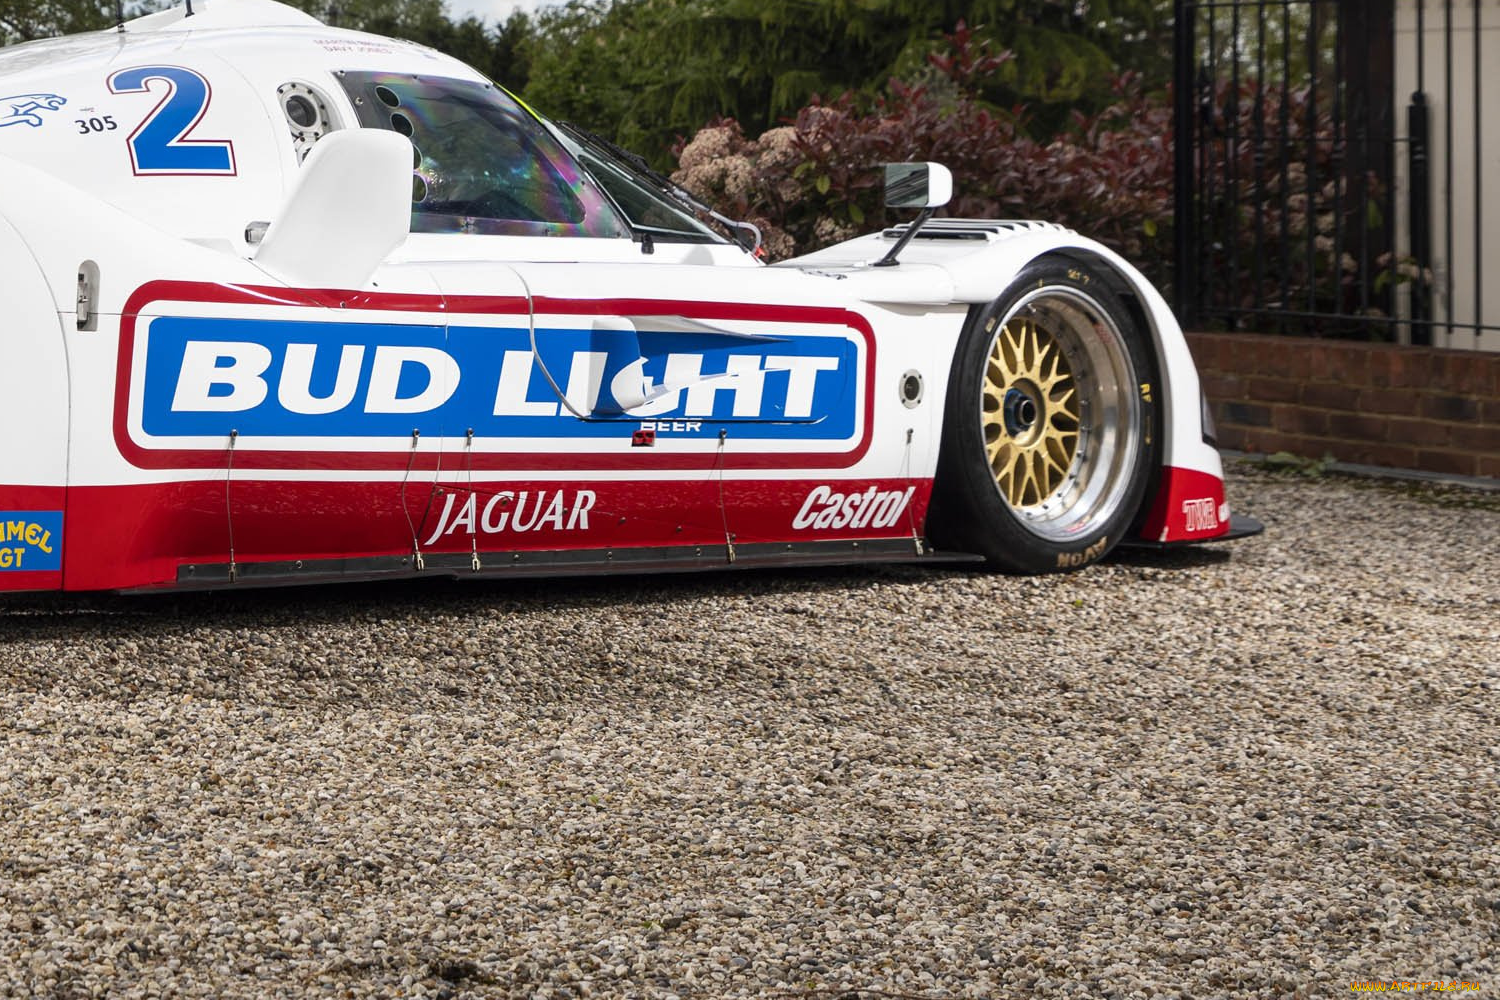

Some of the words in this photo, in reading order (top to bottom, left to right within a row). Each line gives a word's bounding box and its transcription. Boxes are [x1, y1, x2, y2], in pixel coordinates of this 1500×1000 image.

[74, 115, 118, 135] 305
[106, 64, 237, 176] 2
[170, 341, 461, 416] BUD
[492, 350, 839, 418] LIGHT
[640, 417, 703, 432] BEER
[423, 489, 597, 546] JAGUAR
[791, 485, 917, 530] Castrol
